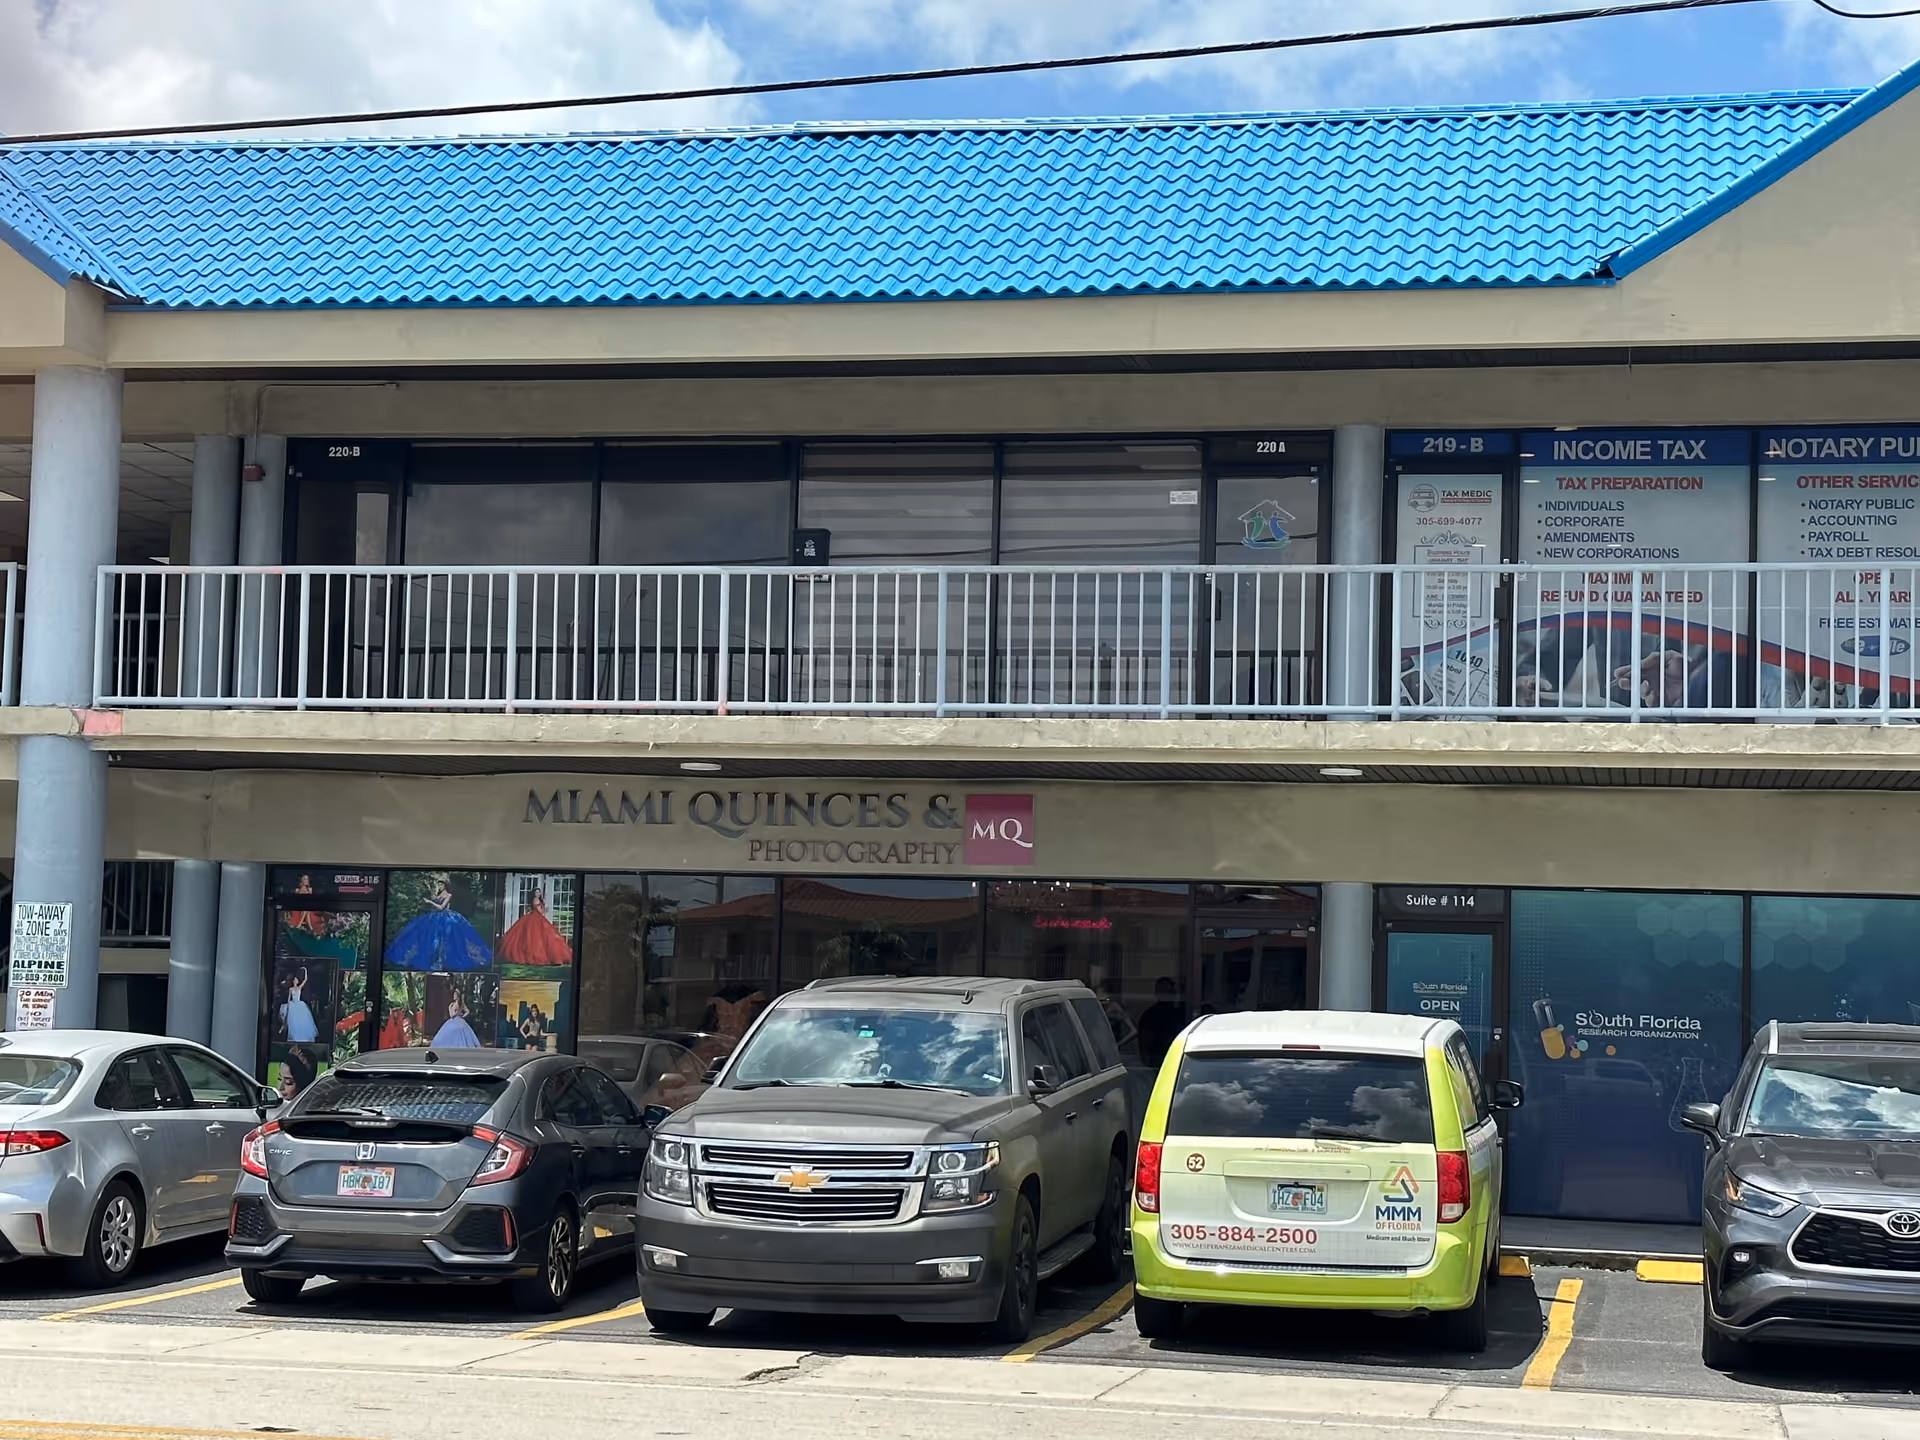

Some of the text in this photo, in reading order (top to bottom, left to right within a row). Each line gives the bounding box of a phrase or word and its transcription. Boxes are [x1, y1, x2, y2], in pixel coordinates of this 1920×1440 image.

[328, 446, 360, 457] 220-B
[1257, 442, 1285, 452] 220 A
[1423, 437, 1457, 453] 219
[1470, 437, 1484, 452] B
[1553, 440, 1706, 460] INCOME TAX
[1769, 437, 1920, 458] NOTARY PU
[1556, 477, 1703, 490] TAX PREPARATION
[1797, 474, 1920, 489] OTHER SERVIC
[1461, 490, 1492, 498] MEDIC
[1545, 501, 1625, 512] INDIVIDUALS
[1808, 499, 1915, 510] NOTARY PUBLIC
[1544, 516, 1625, 527] CORPORATE
[1808, 515, 1897, 526] ACCOUNTING
[1544, 532, 1635, 543] AMENDMENTS
[1808, 531, 1869, 542] PAYROLL
[1544, 547, 1680, 559] NEW CORPORATIONS
[1808, 547, 1833, 558] TAX
[1836, 547, 1873, 558] DEBT
[1582, 572, 1654, 585] MAXIMM
[522, 788, 963, 838] MIAMI QUINCES &
[970, 818, 1033, 848] MQ
[748, 838, 962, 864] PHOTOGRAPHY
[1406, 894, 1475, 907] Suite # 114
[18, 904, 66, 920] TOW-AWAY
[26, 920, 51, 936] ZONE
[58, 921, 64, 929] 7
[53, 929, 67, 937] DAYS
[12, 960, 65, 969] ALPINE
[1412, 981, 1468, 991] South Florida
[1420, 1000, 1460, 1011] OPEN
[1575, 1010, 1702, 1030] South Florida
[1578, 1027, 1700, 1040] RESEARCH ORGANIZATION
[1188, 1157, 1204, 1170] 52
[1375, 1205, 1422, 1222] MMM
[1376, 1221, 1421, 1231] OF FLORIDA
[1171, 1224, 1318, 1245] 305-884-2500
